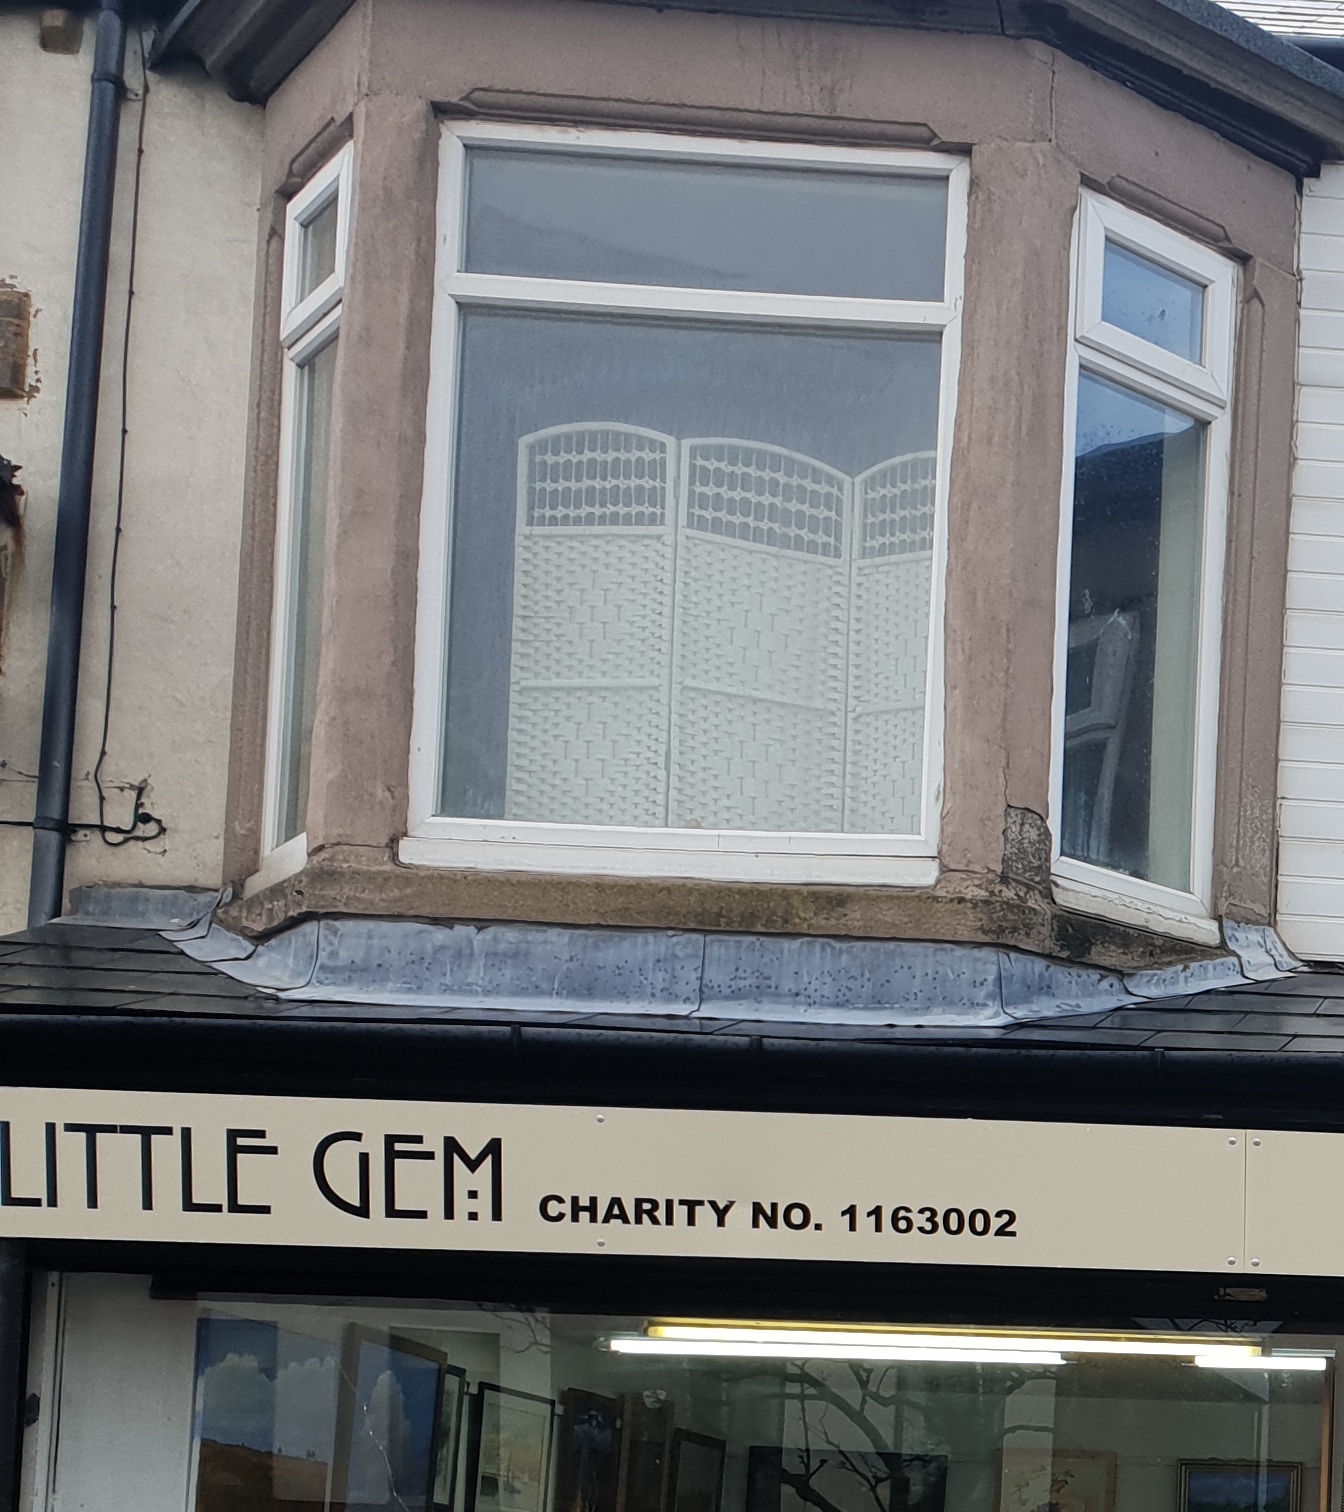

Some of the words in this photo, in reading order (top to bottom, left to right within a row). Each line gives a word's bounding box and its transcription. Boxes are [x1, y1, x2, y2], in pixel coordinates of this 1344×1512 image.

[0, 1121, 278, 1214] LITTLE
[313, 1131, 503, 1221] GEM
[538, 1194, 736, 1228] CHARITY
[751, 1202, 823, 1231] NO.
[841, 1204, 1018, 1237] 1163002
